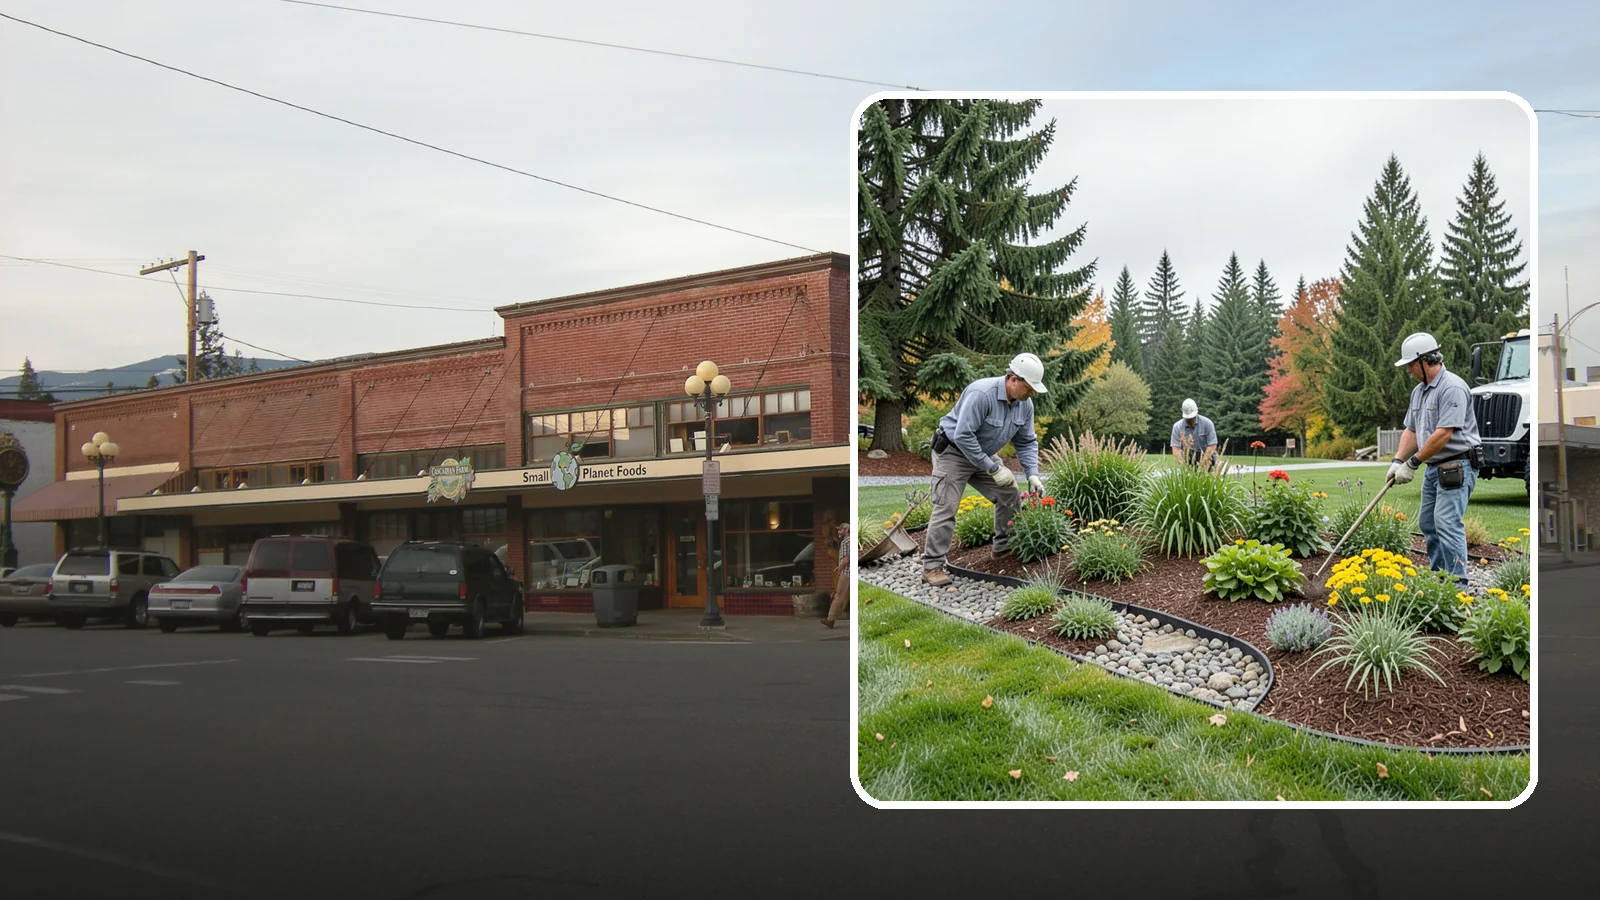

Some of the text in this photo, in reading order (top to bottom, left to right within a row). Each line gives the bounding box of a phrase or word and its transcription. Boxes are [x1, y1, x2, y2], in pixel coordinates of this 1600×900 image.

[523, 464, 647, 483] Small Planet Foods
